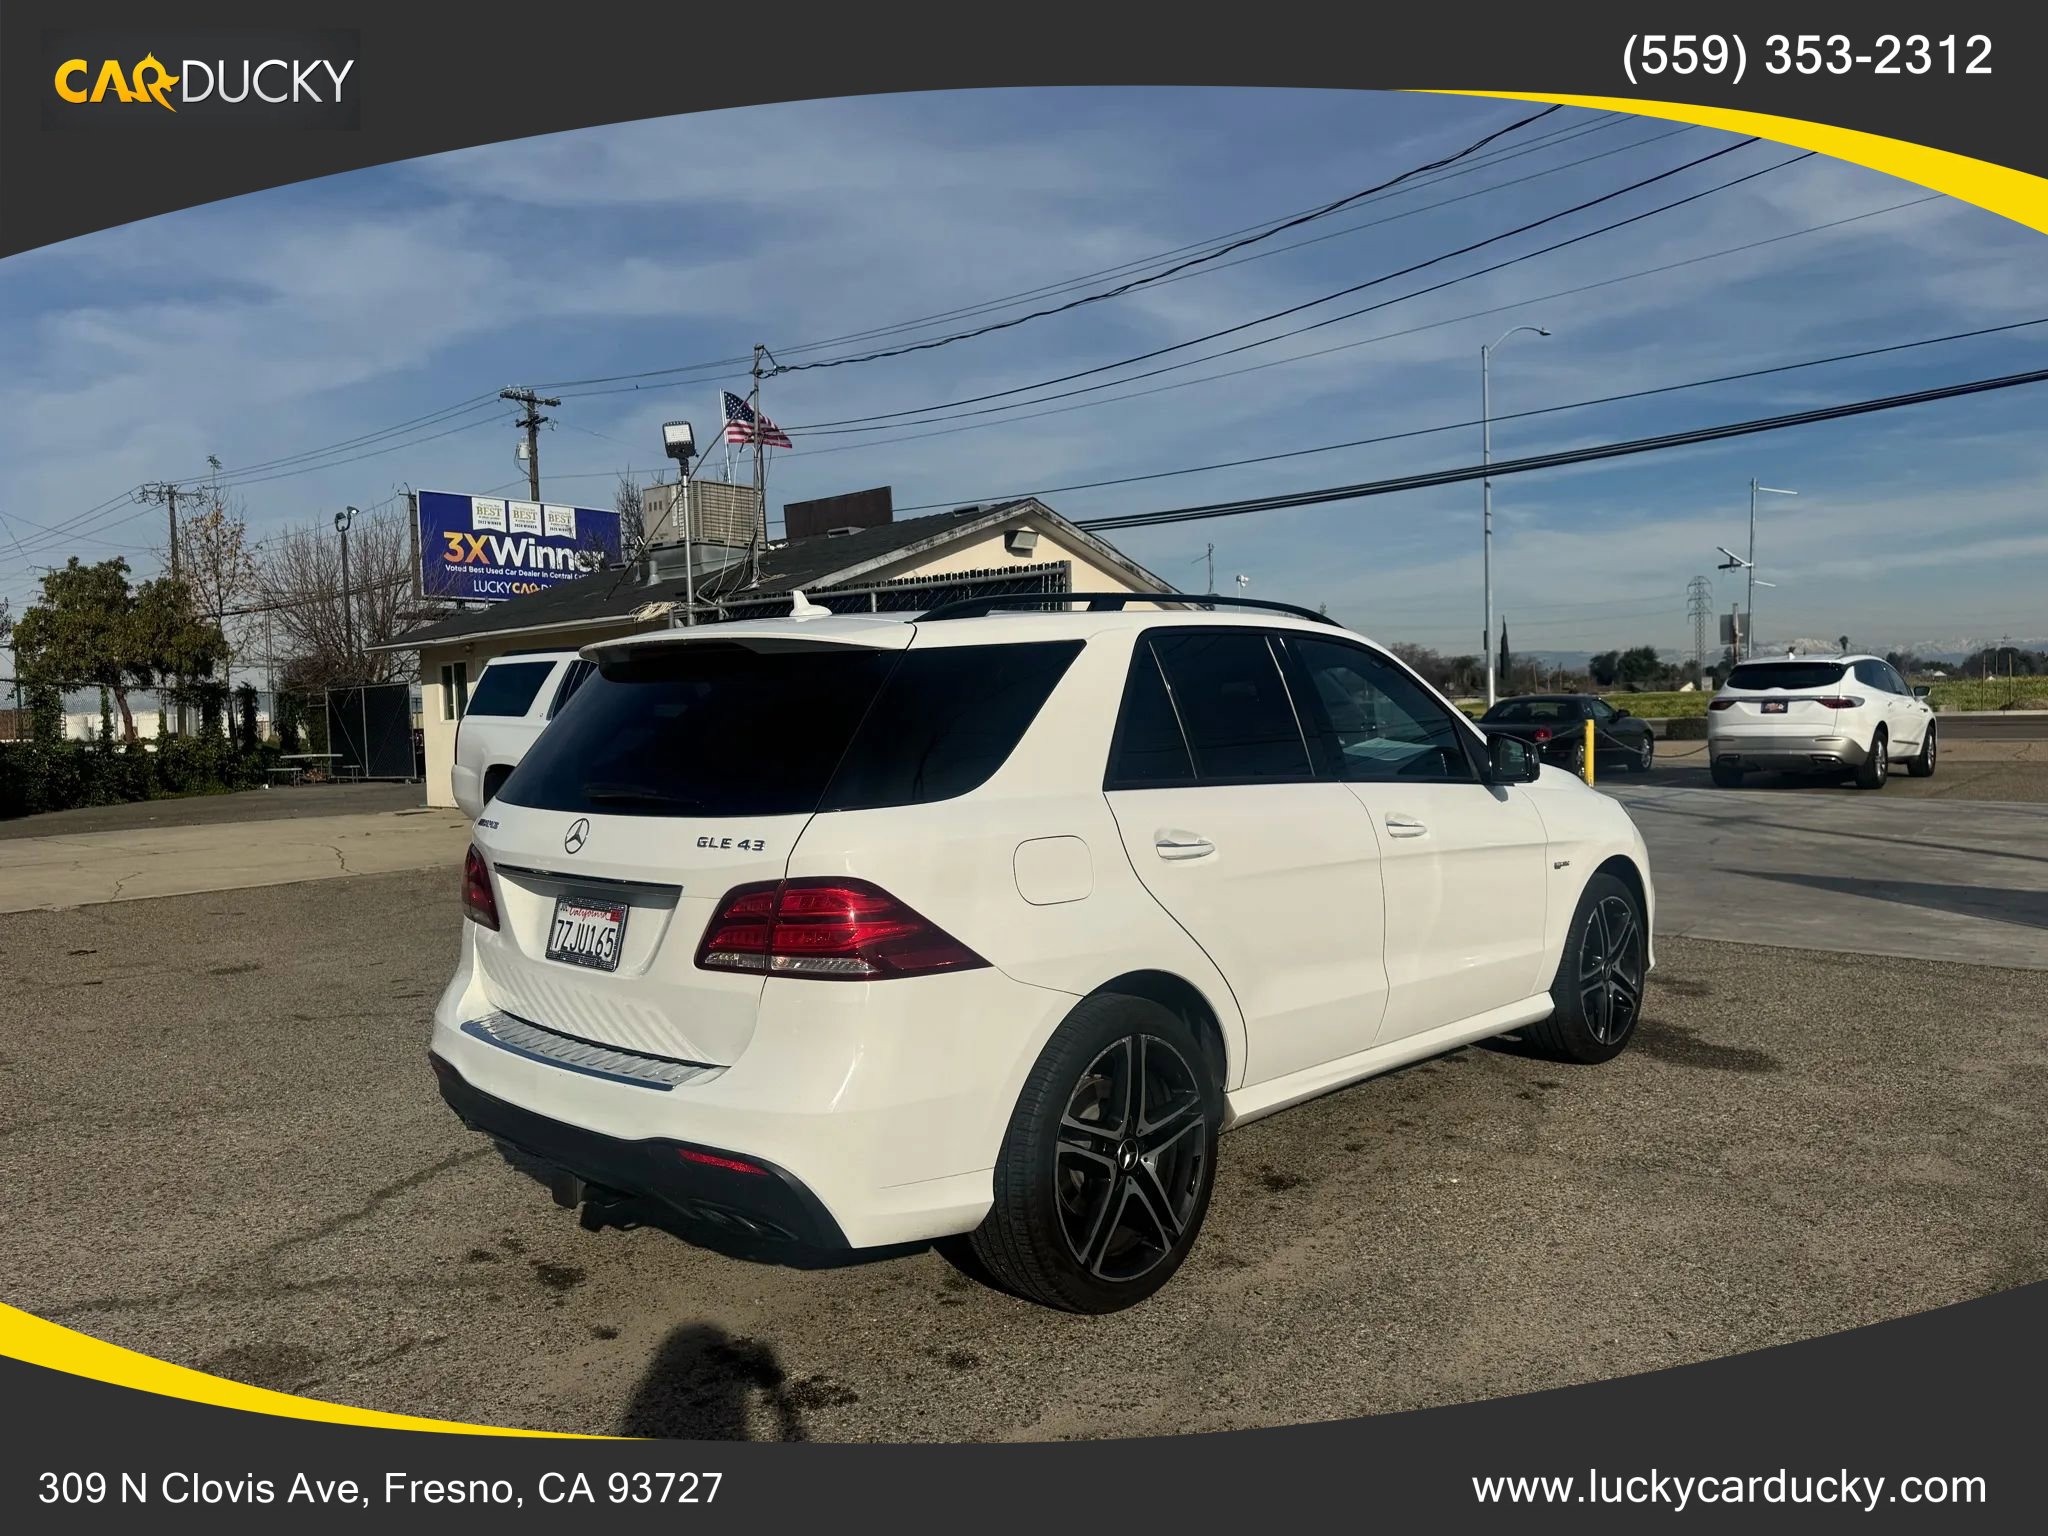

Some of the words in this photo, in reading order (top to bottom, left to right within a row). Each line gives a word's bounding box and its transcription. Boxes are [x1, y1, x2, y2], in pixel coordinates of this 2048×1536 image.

[476, 506, 502, 517] BEST
[512, 510, 538, 520] BEST
[548, 513, 571, 524] BEST
[445, 564, 467, 573] Voted
[469, 566, 484, 574] Best
[486, 567, 503, 575] Used
[505, 568, 517, 576] Car
[519, 569, 540, 577] Dealer
[549, 571, 573, 580] Central
[696, 836, 733, 849] GLE
[737, 839, 765, 851] 43
[554, 919, 616, 958] 7ZJU165
